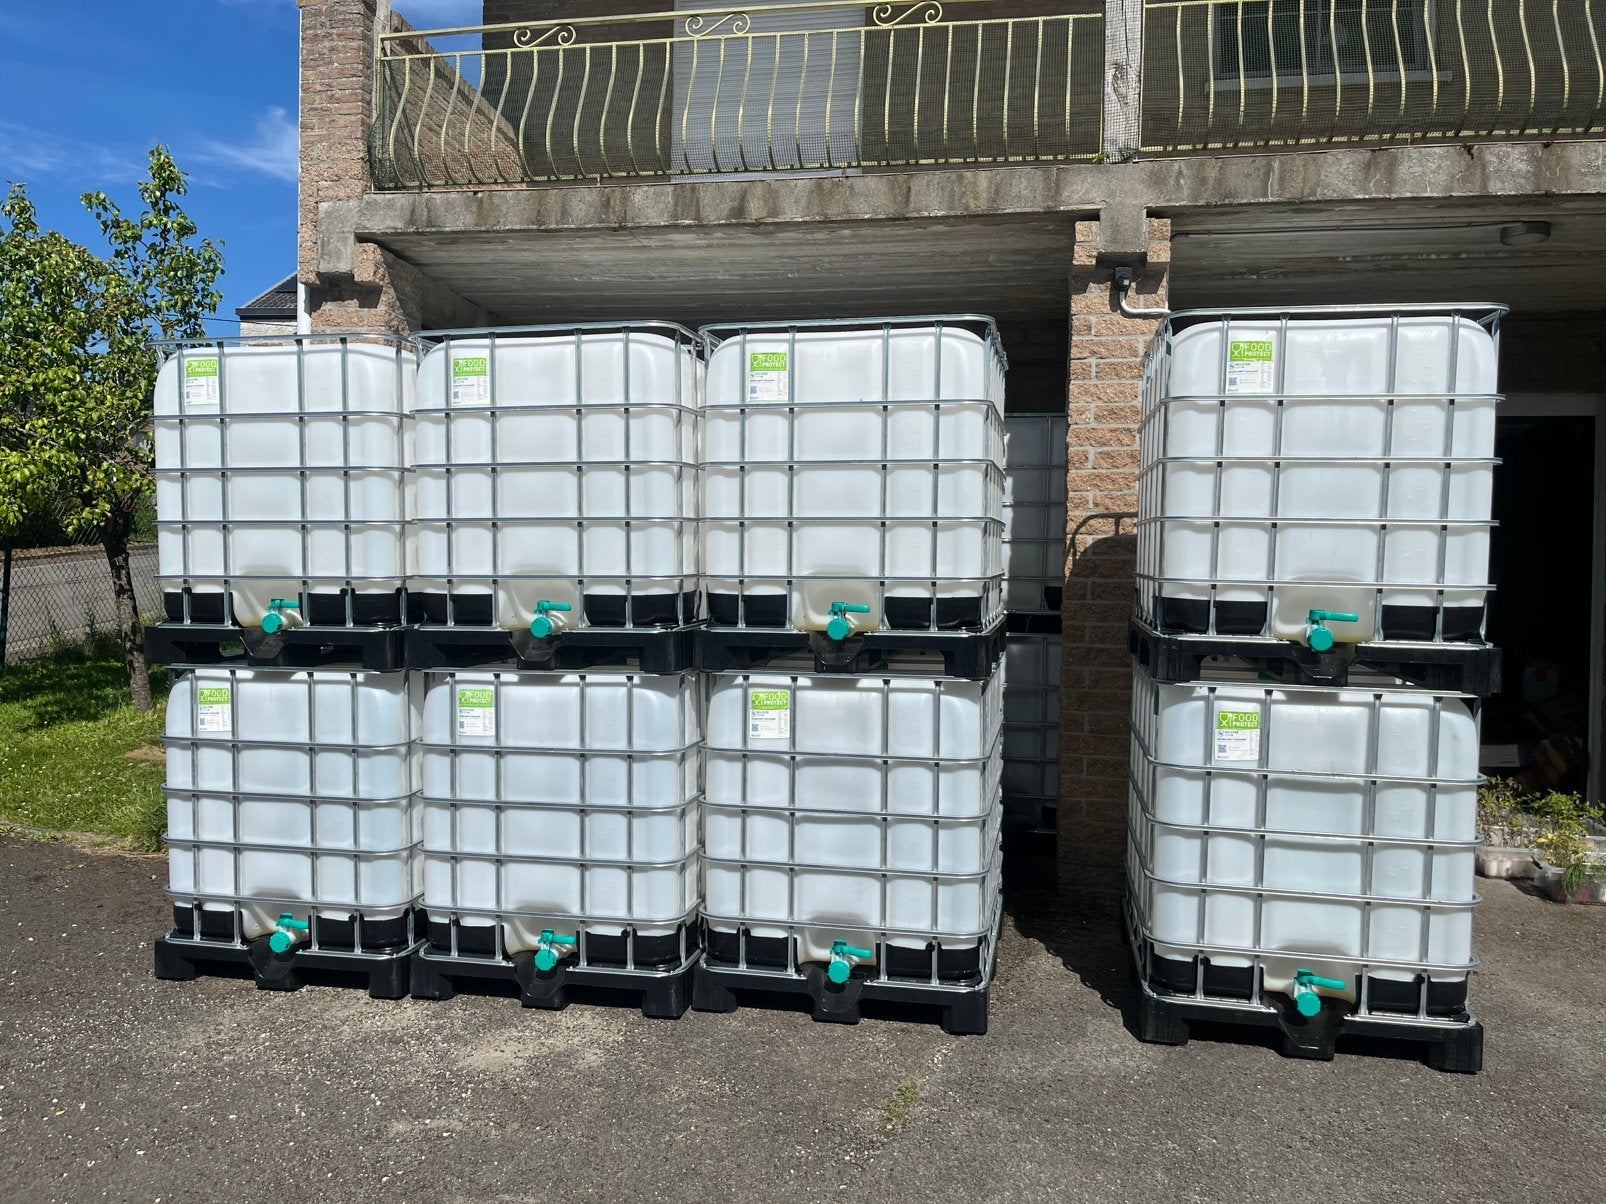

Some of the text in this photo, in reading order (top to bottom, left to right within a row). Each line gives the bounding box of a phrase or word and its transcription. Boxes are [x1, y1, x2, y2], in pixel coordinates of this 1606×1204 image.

[1244, 342, 1271, 351] FOOD
[762, 354, 786, 362] FOOD
[195, 360, 217, 369] FOOD
[463, 359, 486, 367] FOOD
[470, 690, 492, 699] FOOD
[763, 693, 787, 701] FOOD
[1232, 713, 1258, 722] FOOD
